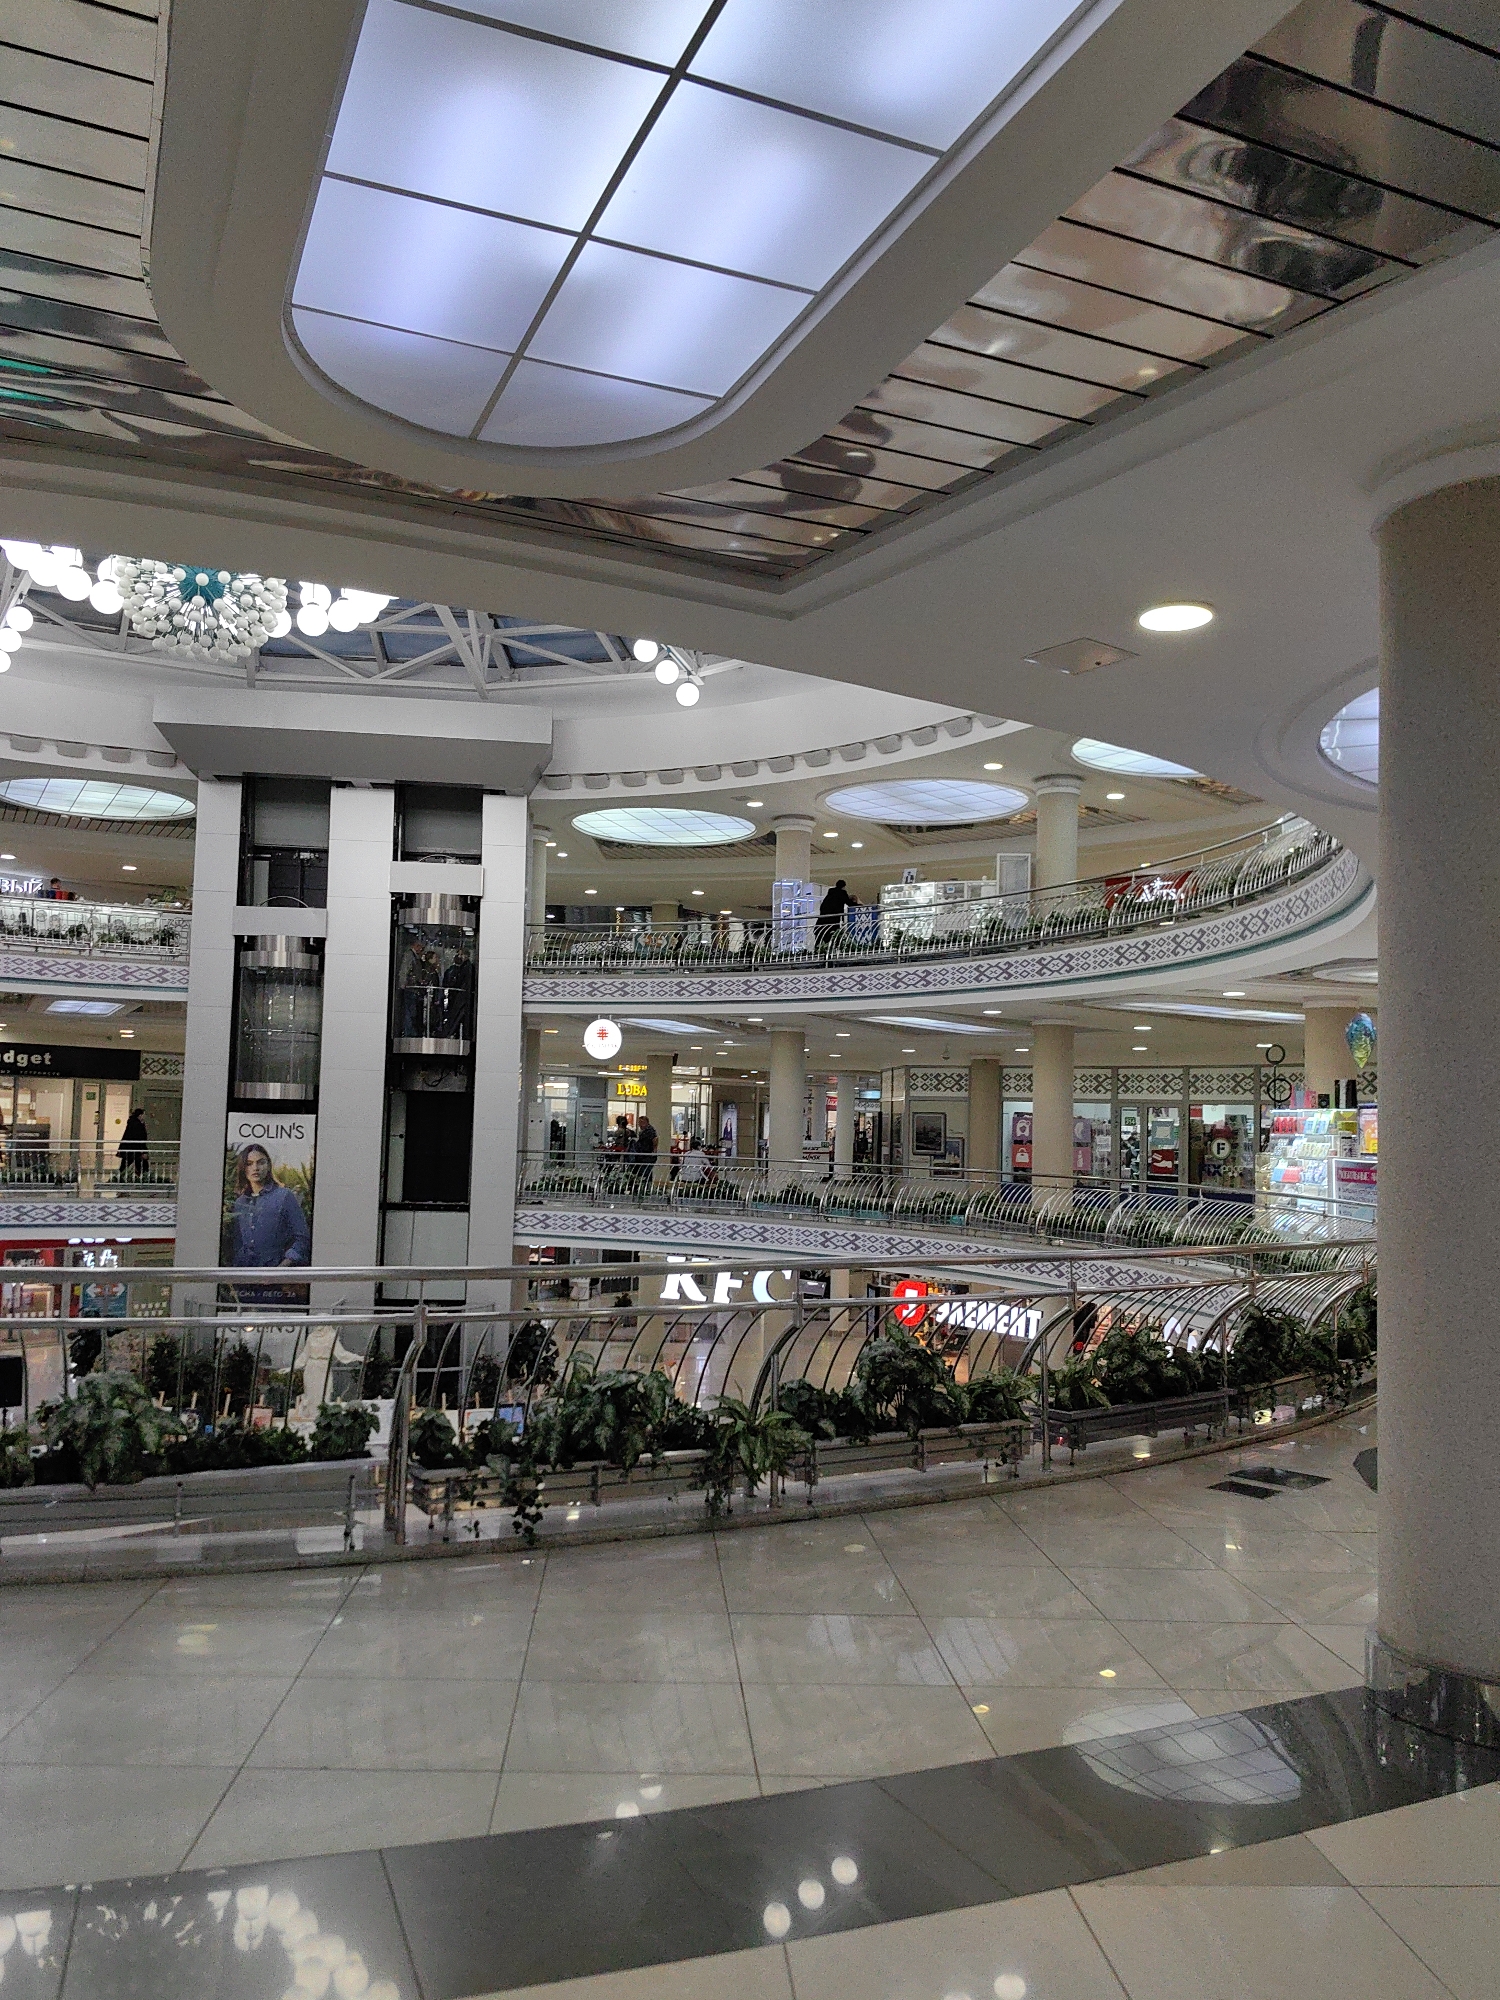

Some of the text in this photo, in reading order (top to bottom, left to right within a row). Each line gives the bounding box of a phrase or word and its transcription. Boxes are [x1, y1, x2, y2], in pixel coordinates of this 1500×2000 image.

[0, 1049, 52, 1068] dget
[617, 1083, 648, 1097] LUBA
[238, 1122, 305, 1140] COLIN'S
[1216, 1142, 1226, 1155] F
[660, 1255, 792, 1304] KFC
